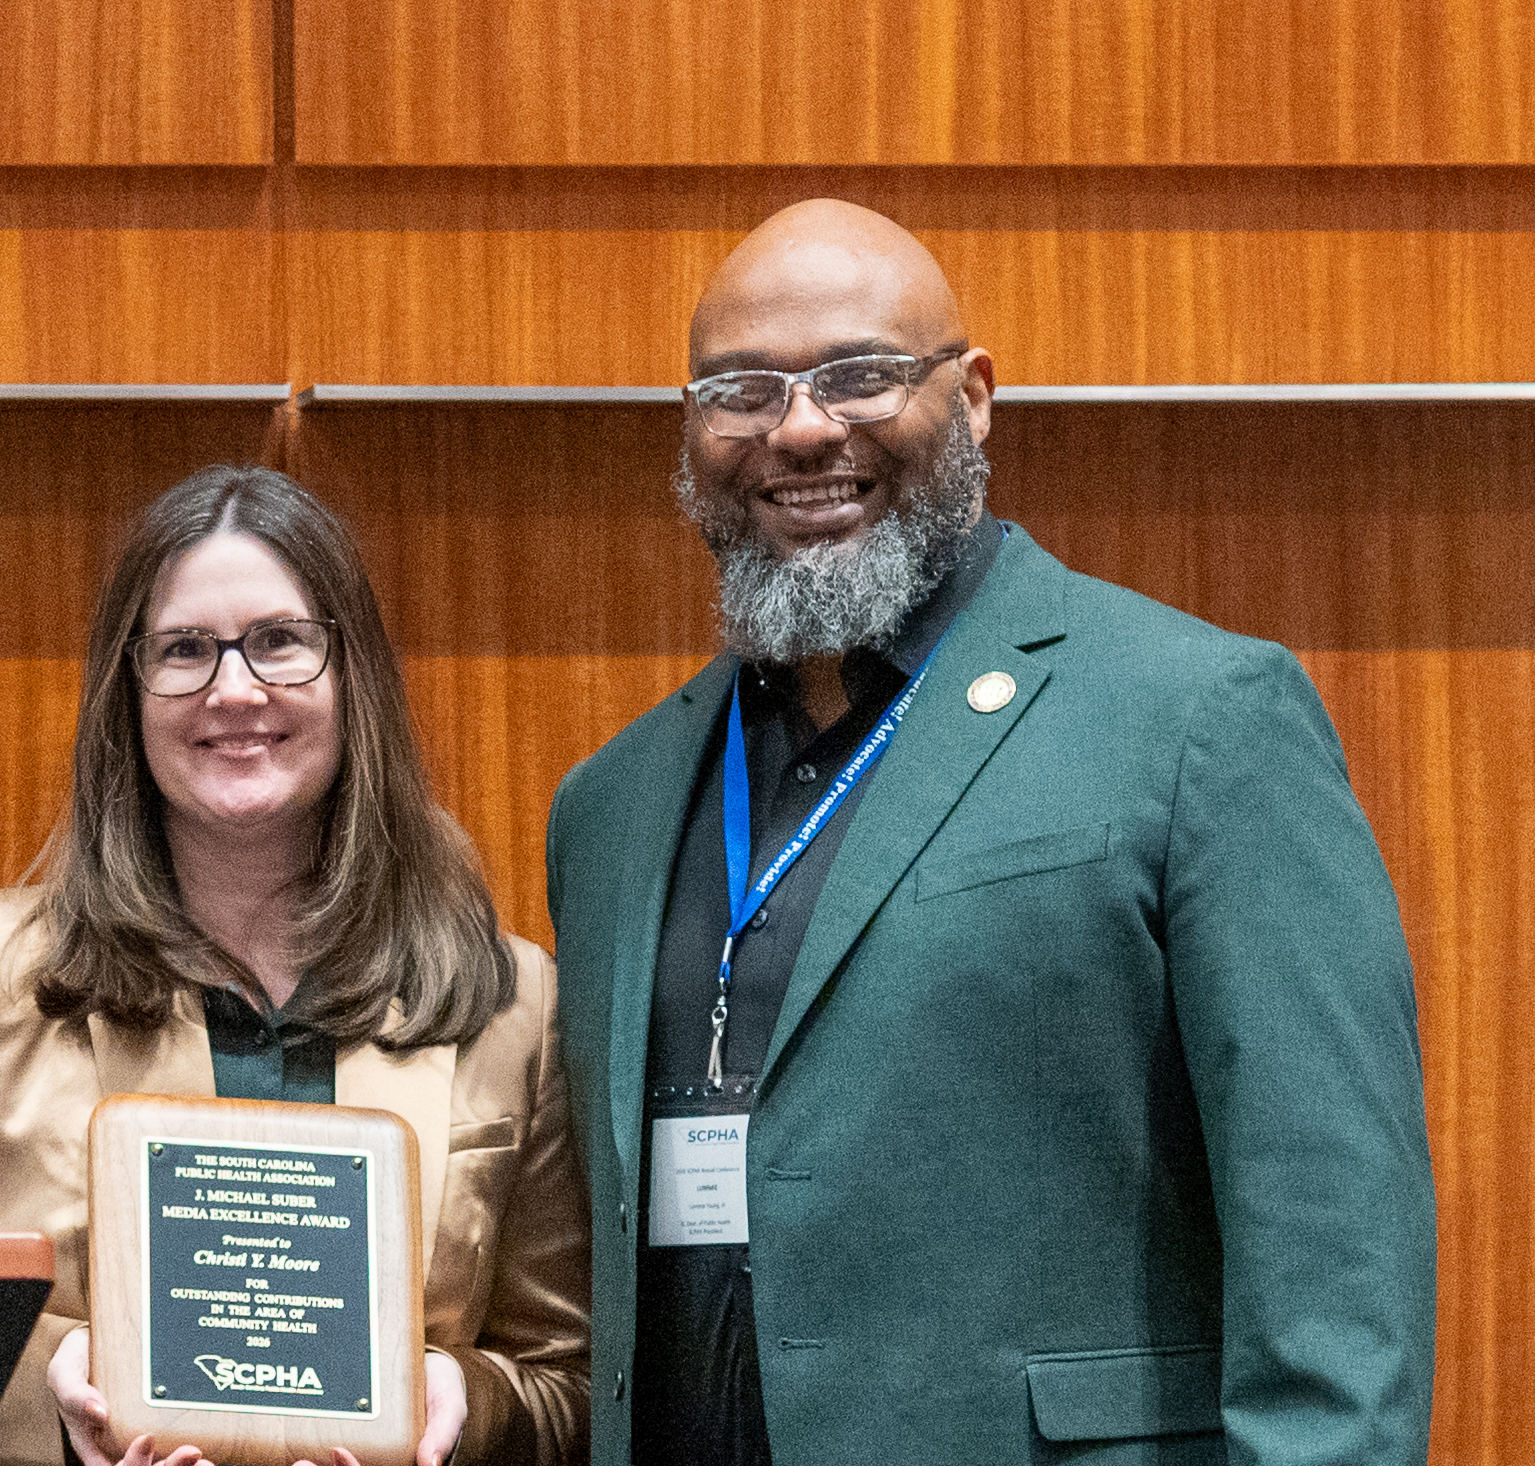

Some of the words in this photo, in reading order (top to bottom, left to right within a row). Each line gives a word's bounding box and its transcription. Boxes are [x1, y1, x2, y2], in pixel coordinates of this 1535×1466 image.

[841, 718, 895, 782] Advocate!
[798, 781, 848, 840] Promote!
[756, 841, 803, 893] Provide!
[687, 1128, 739, 1143] SCPHA
[195, 1155, 218, 1166] THE
[219, 1156, 256, 1168] SOUTH
[258, 1159, 316, 1172] CAROLINA
[175, 1167, 216, 1179] PUBLIC
[217, 1169, 261, 1182] HEALTH
[263, 1173, 336, 1187] ASSOCIATION
[194, 1189, 205, 1201] J.
[207, 1190, 270, 1205] MICHAEL
[272, 1193, 317, 1208] SUBER
[162, 1205, 208, 1220] MEDIA
[209, 1208, 298, 1226] EXCELLENCE
[300, 1215, 351, 1229] AWARD
[222, 1234, 279, 1248] Presented
[279, 1238, 292, 1249] to
[193, 1250, 247, 1268] Christi
[251, 1253, 265, 1268] Y.
[268, 1254, 321, 1272] Moore
[245, 1278, 269, 1290] FOR
[170, 1288, 251, 1303] OUTSTANDING
[254, 1294, 345, 1309] CONTRIBUTIONS
[211, 1304, 224, 1314] IN
[228, 1305, 251, 1317] THE
[255, 1307, 286, 1319] AREA
[289, 1308, 306, 1320] OF
[198, 1317, 269, 1331] COMMUNITY
[273, 1321, 317, 1334] HEALTH
[215, 1362, 323, 1389] SCPHA
